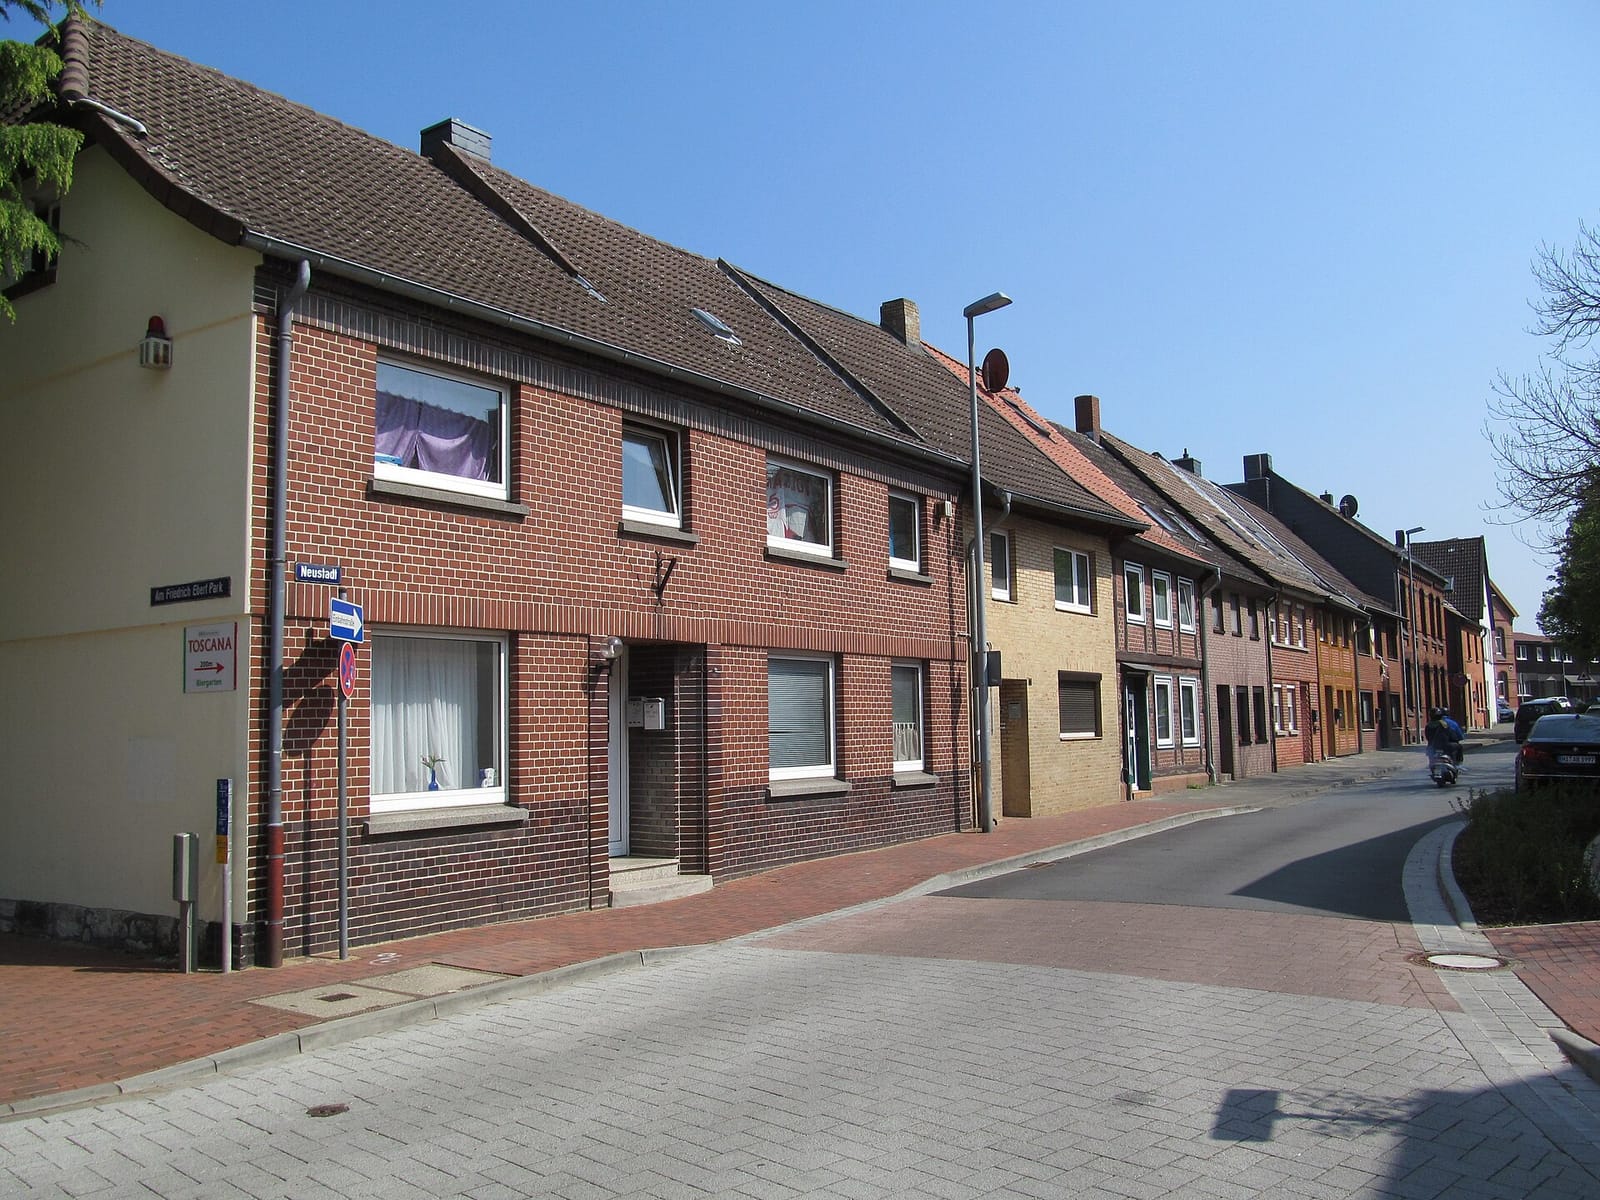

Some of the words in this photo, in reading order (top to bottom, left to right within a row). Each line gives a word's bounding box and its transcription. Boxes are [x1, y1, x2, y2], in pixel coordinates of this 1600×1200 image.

[300, 565, 338, 580] Neustadt
[154, 590, 165, 601] Am
[165, 585, 191, 600] Friedrich
[192, 583, 208, 597] Ebert
[208, 581, 224, 594] Park
[188, 637, 232, 653] TOSCANA
